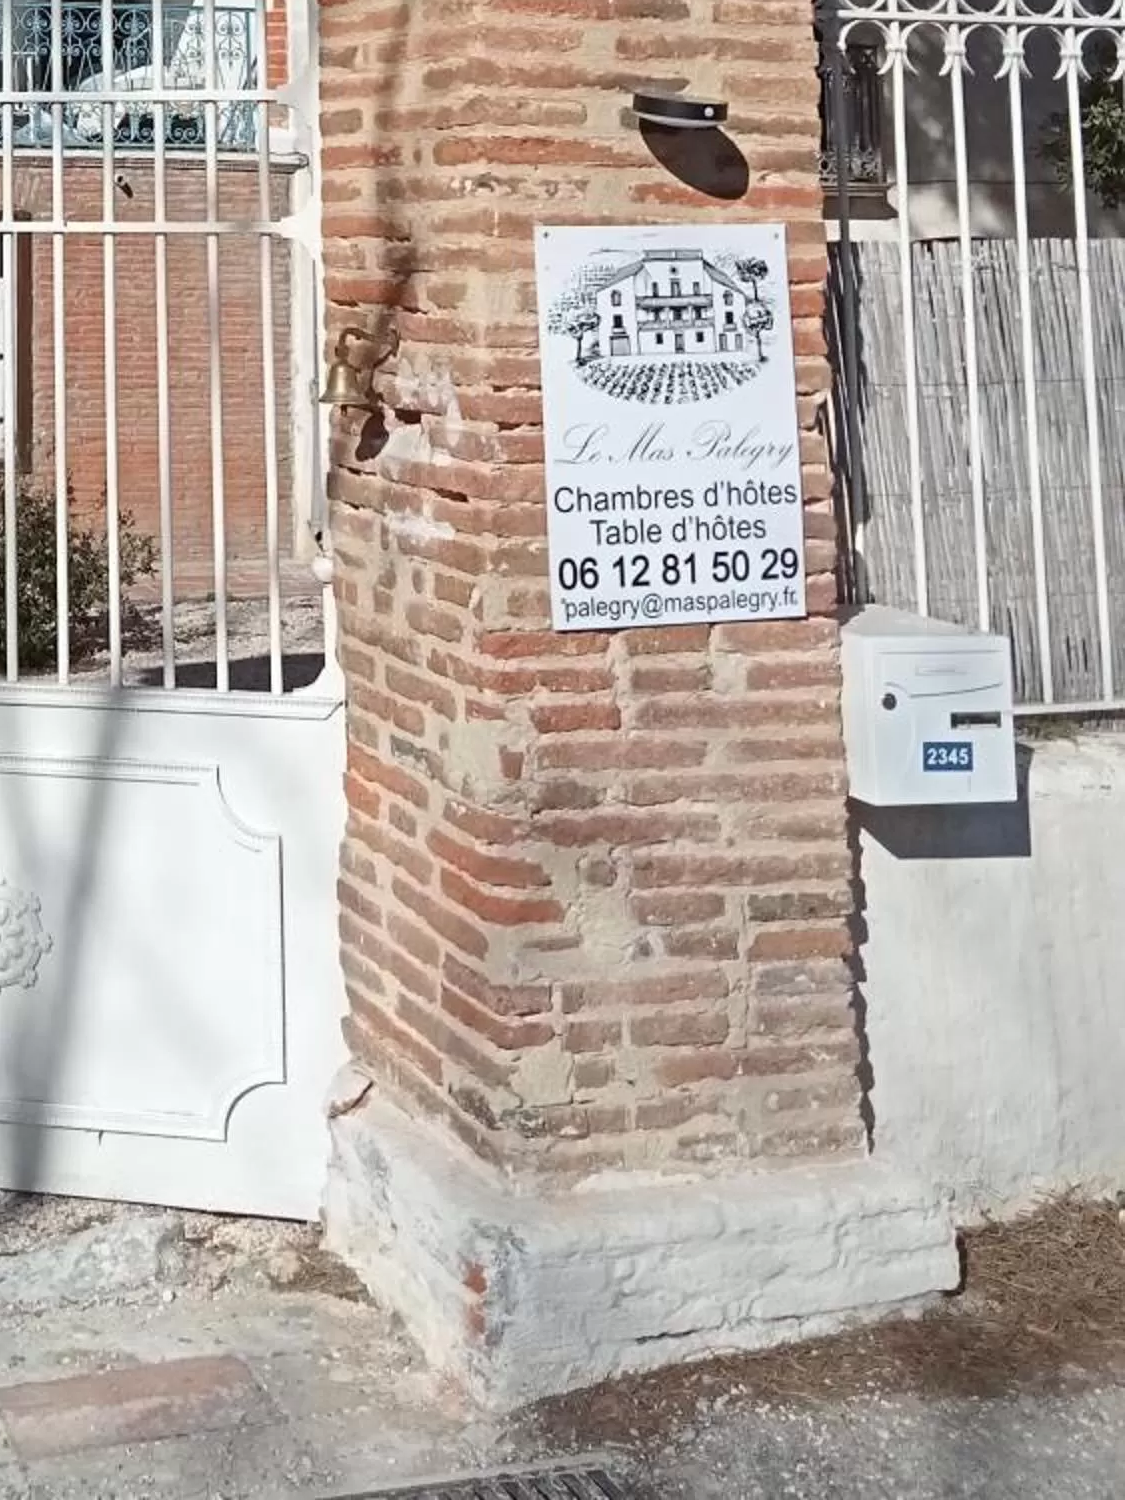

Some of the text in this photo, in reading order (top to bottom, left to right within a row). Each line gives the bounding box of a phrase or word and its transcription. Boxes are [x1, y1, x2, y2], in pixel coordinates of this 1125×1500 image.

[553, 479, 798, 514] Chambres d'hôtes
[589, 514, 767, 546] Table d'hôtes
[558, 548, 799, 590] 06 12 81 50 29
[564, 585, 796, 622] palegry@maspalegry.fr
[926, 747, 970, 765] 2345
